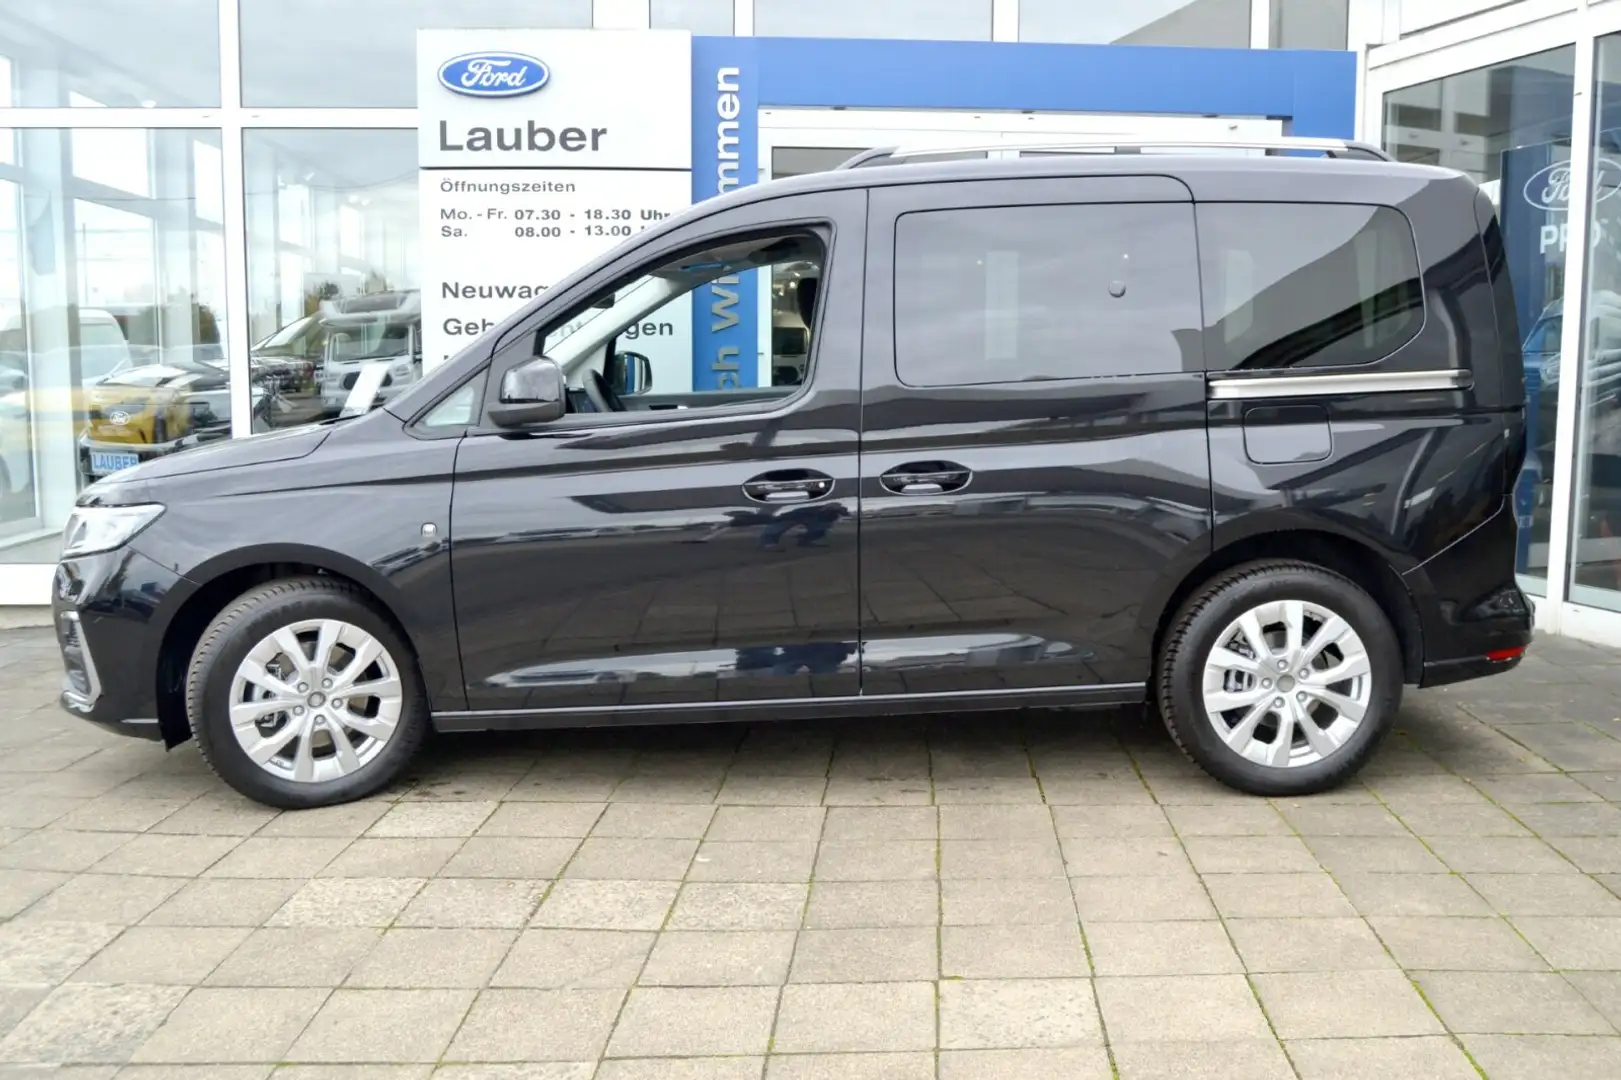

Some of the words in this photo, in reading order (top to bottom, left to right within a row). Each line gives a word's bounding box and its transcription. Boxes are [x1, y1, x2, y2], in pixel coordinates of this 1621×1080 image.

[461, 59, 528, 87] Ford
[439, 120, 608, 151] Lauber
[440, 178, 576, 195] Öffnungszeiten
[515, 209, 561, 220] 07.30
[584, 209, 632, 220] 18.30
[441, 226, 468, 237] Sa.
[515, 226, 561, 237] 08.00
[584, 225, 632, 237] 13.00
